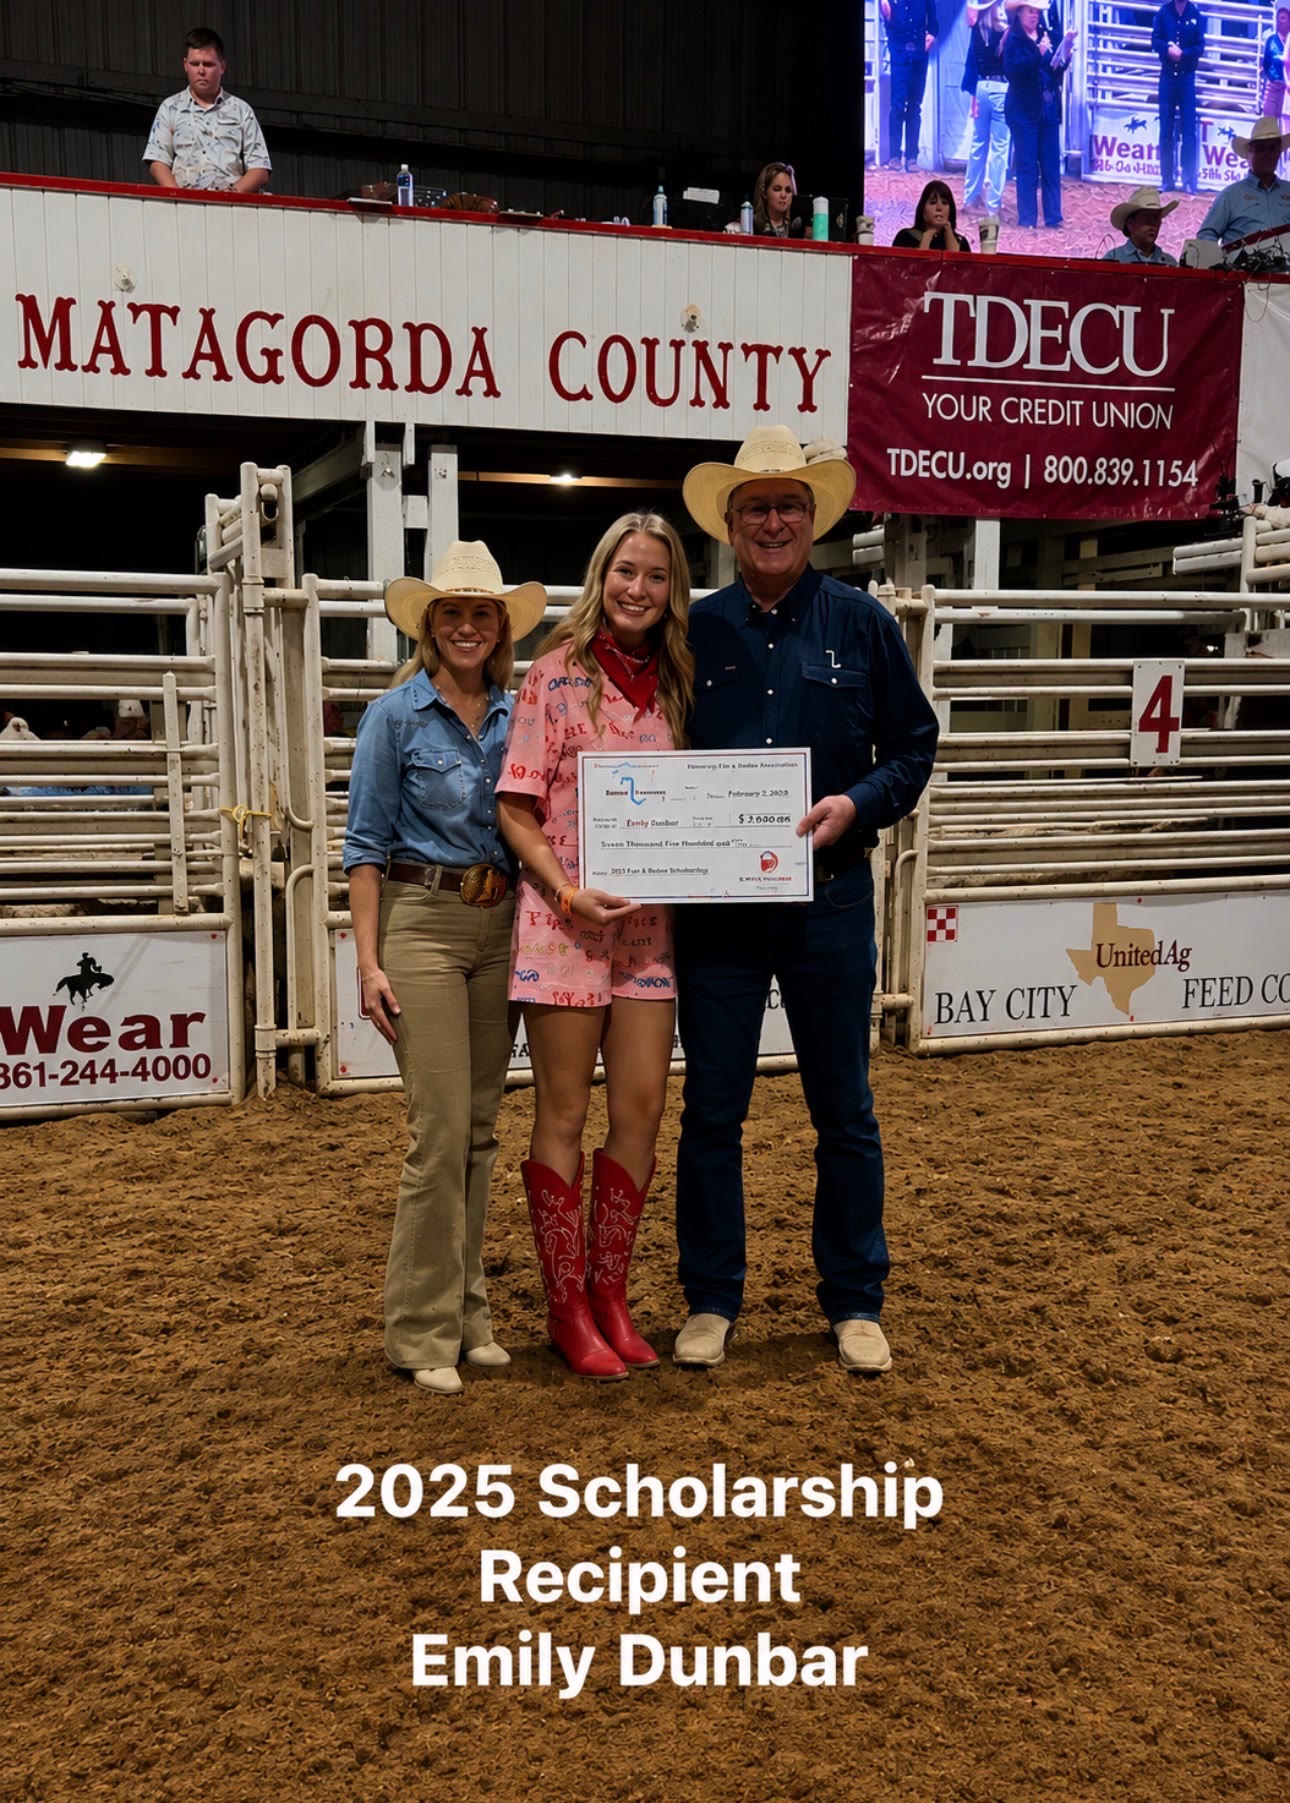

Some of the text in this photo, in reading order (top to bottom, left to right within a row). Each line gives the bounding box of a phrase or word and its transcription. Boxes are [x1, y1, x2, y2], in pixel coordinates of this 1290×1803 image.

[15, 293, 832, 414] MATAGORDA COUNTY
[923, 291, 1175, 377] TDECU
[922, 392, 1173, 430] YOUR CREDIT UNION
[887, 447, 1011, 489] TDECU.org
[1043, 455, 1198, 487] 800.839.1154
[1138, 675, 1180, 754] 4
[1095, 940, 1192, 972] UnitedAg
[934, 984, 1078, 1025] BAY CITY
[1181, 975, 1254, 1009] FEED
[0, 1004, 206, 1056] Wear
